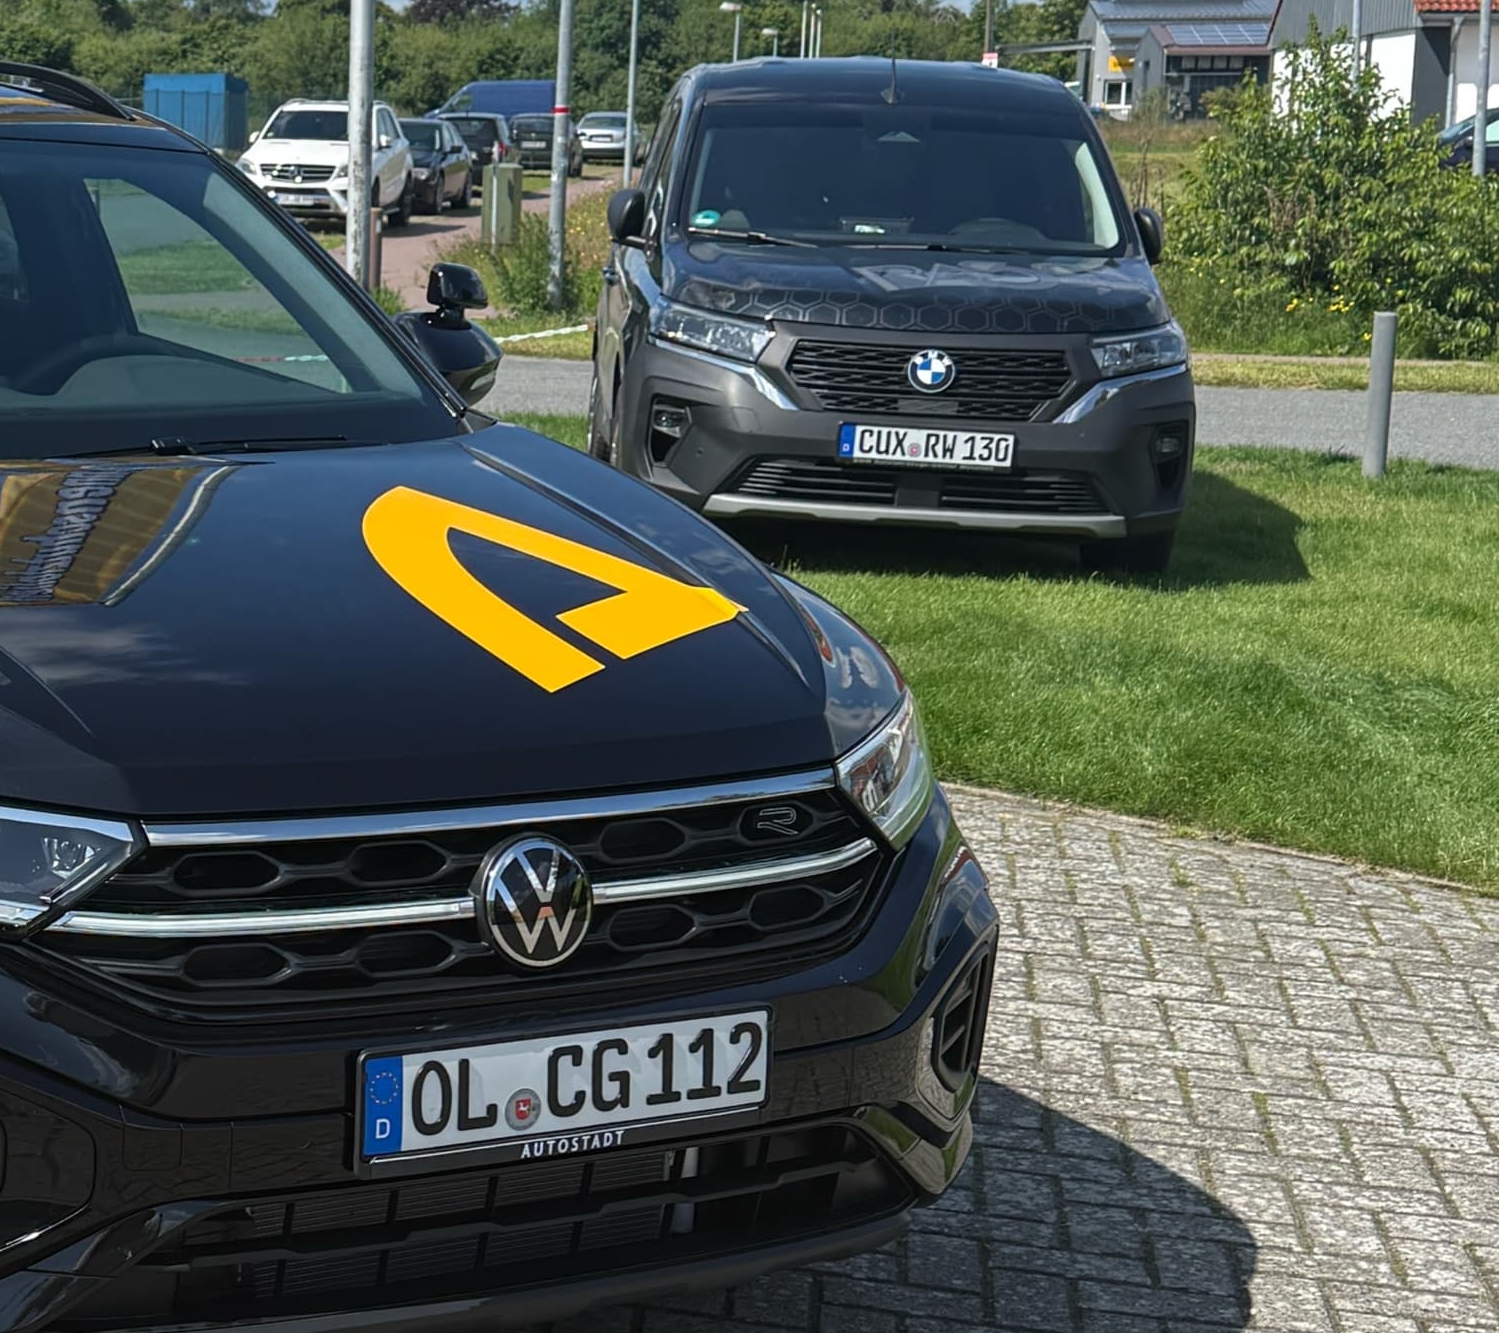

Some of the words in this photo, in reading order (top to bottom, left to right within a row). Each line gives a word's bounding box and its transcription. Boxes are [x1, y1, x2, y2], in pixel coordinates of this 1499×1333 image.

[859, 428, 909, 457] CUX
[924, 432, 958, 460] RW
[962, 435, 1011, 463] 130
[375, 1118, 391, 1140] D
[411, 1058, 498, 1136] OL
[546, 1037, 631, 1118] CG
[646, 1021, 764, 1106] 112
[520, 1129, 625, 1159] AUTOSTADT
